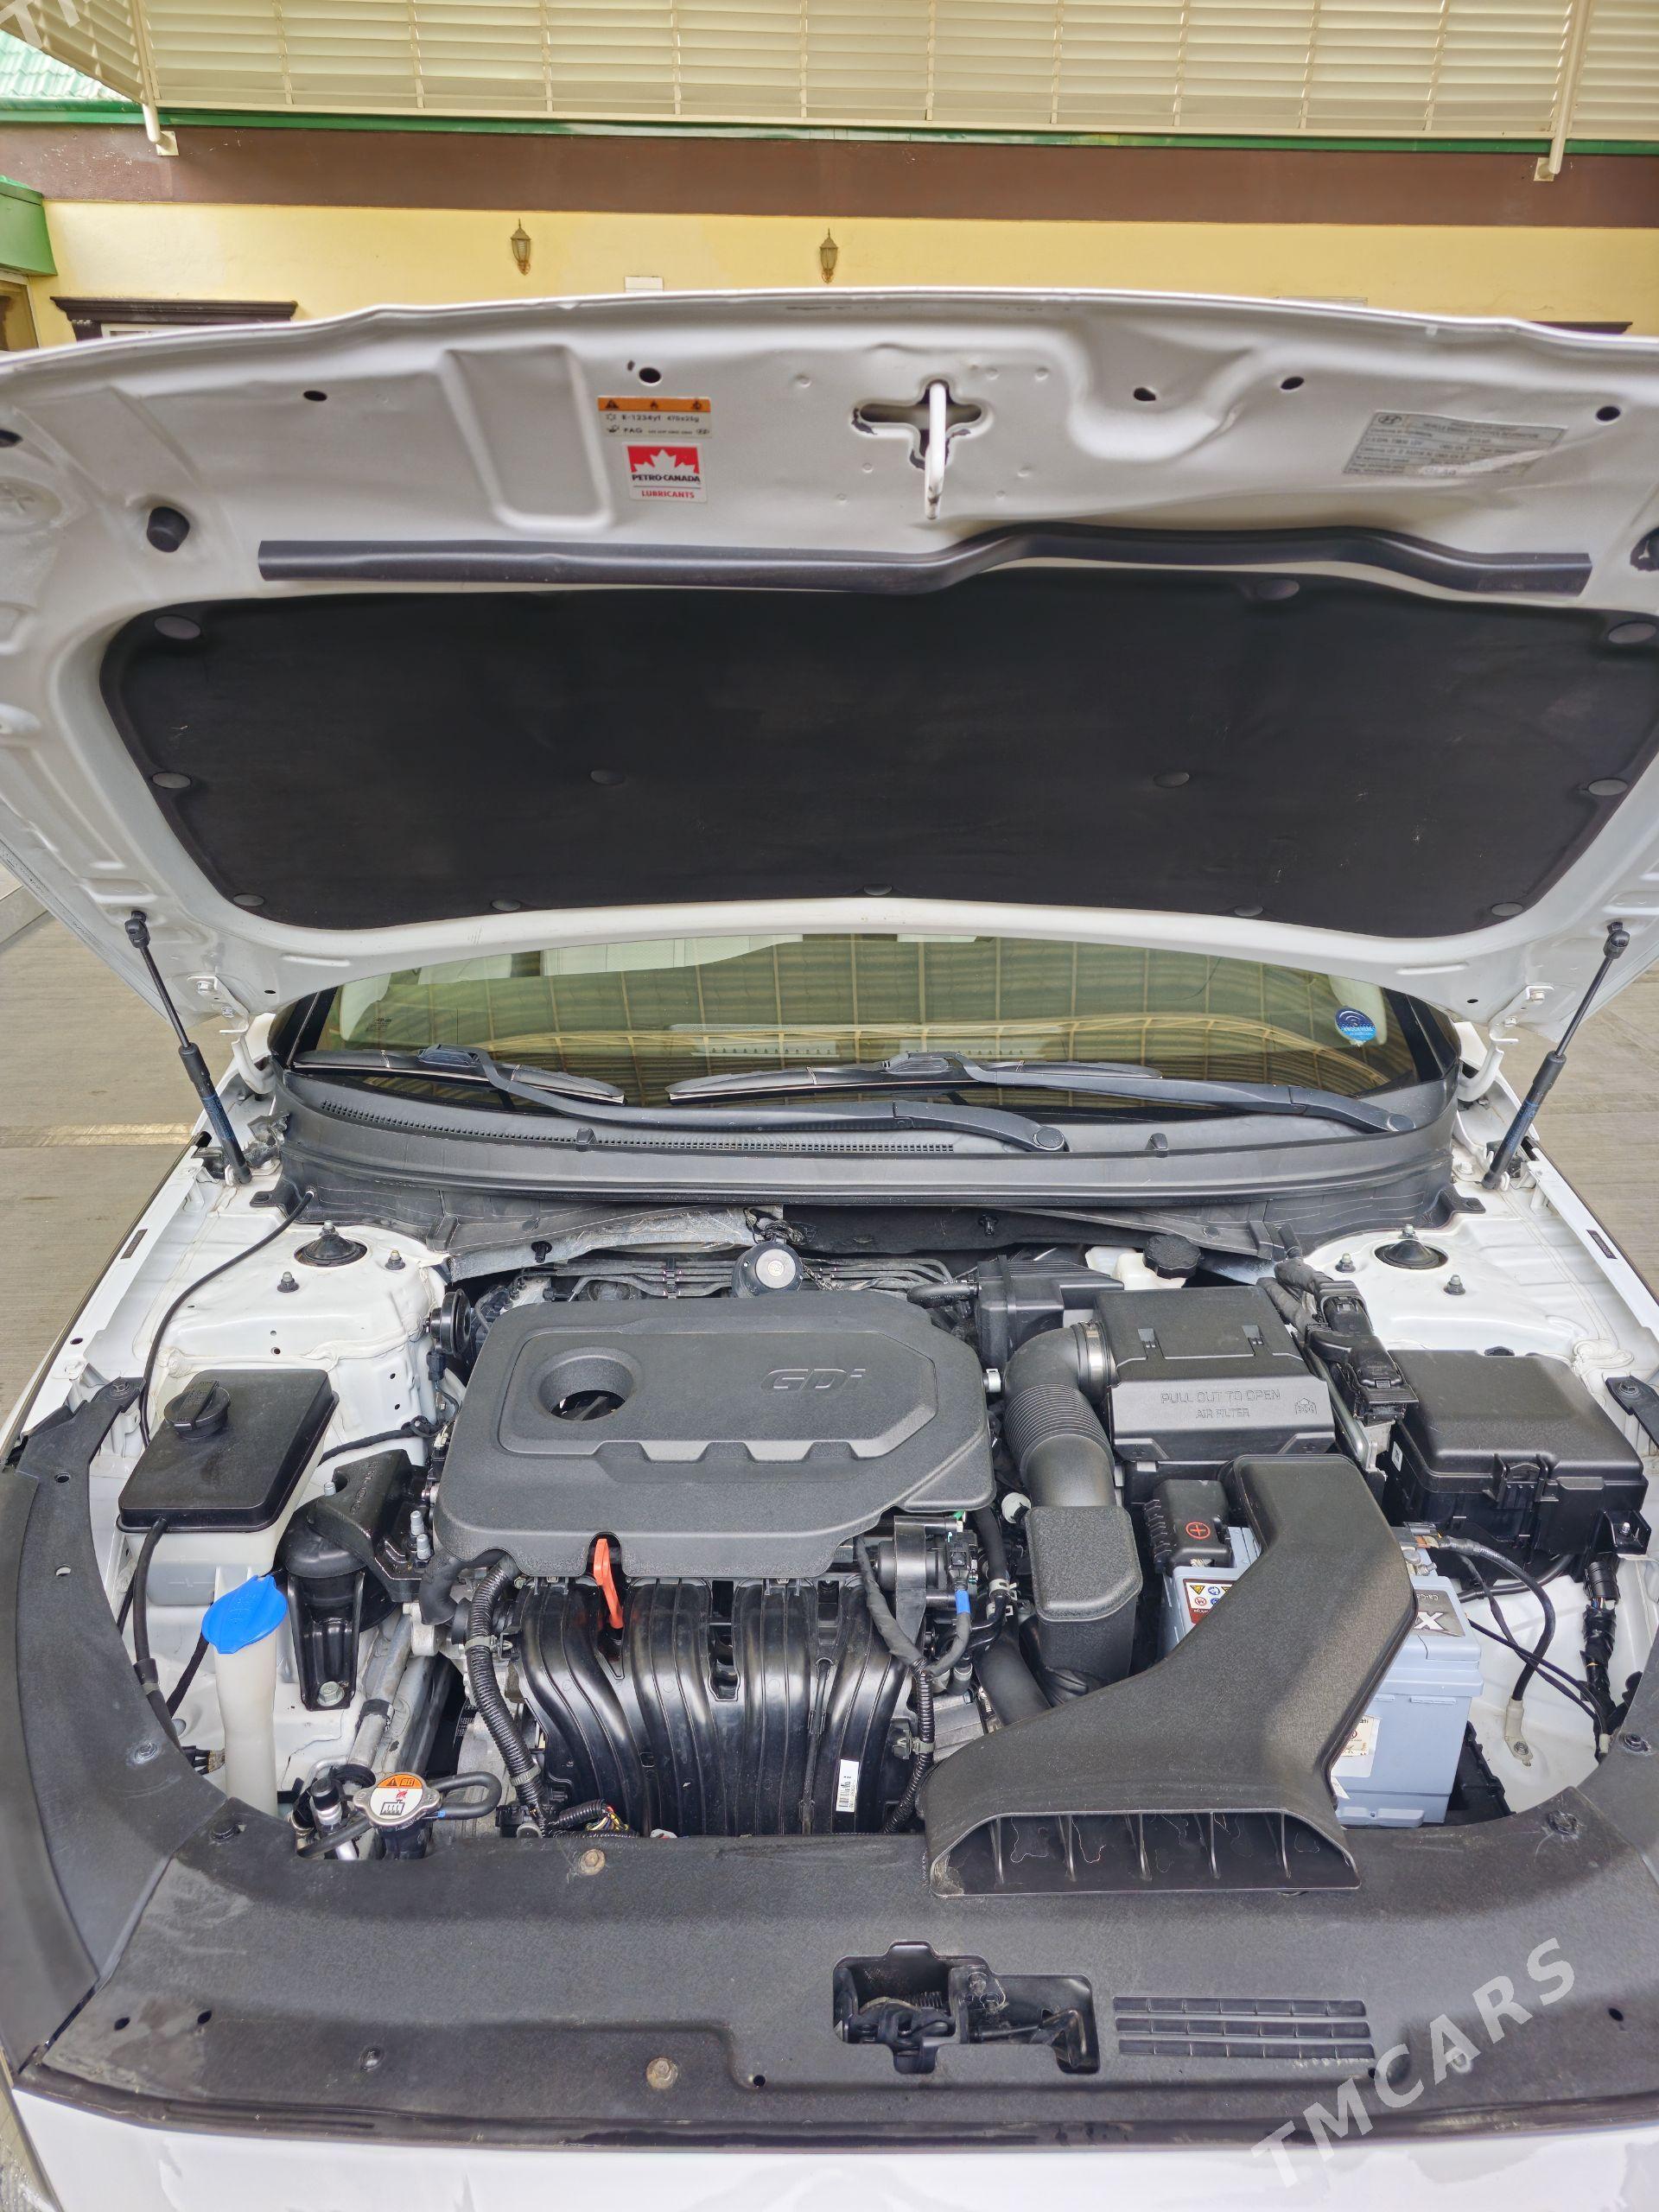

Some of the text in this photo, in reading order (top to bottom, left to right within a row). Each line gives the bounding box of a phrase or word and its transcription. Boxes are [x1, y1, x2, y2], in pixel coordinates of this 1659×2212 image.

[632, 474, 701, 482] PETRO-CANADA
[641, 490, 695, 499] LUBRICANTS
[1160, 1389, 1281, 1403] PULL OUT TO OPEN
[1196, 1408, 1250, 1419] AIR FILTER
